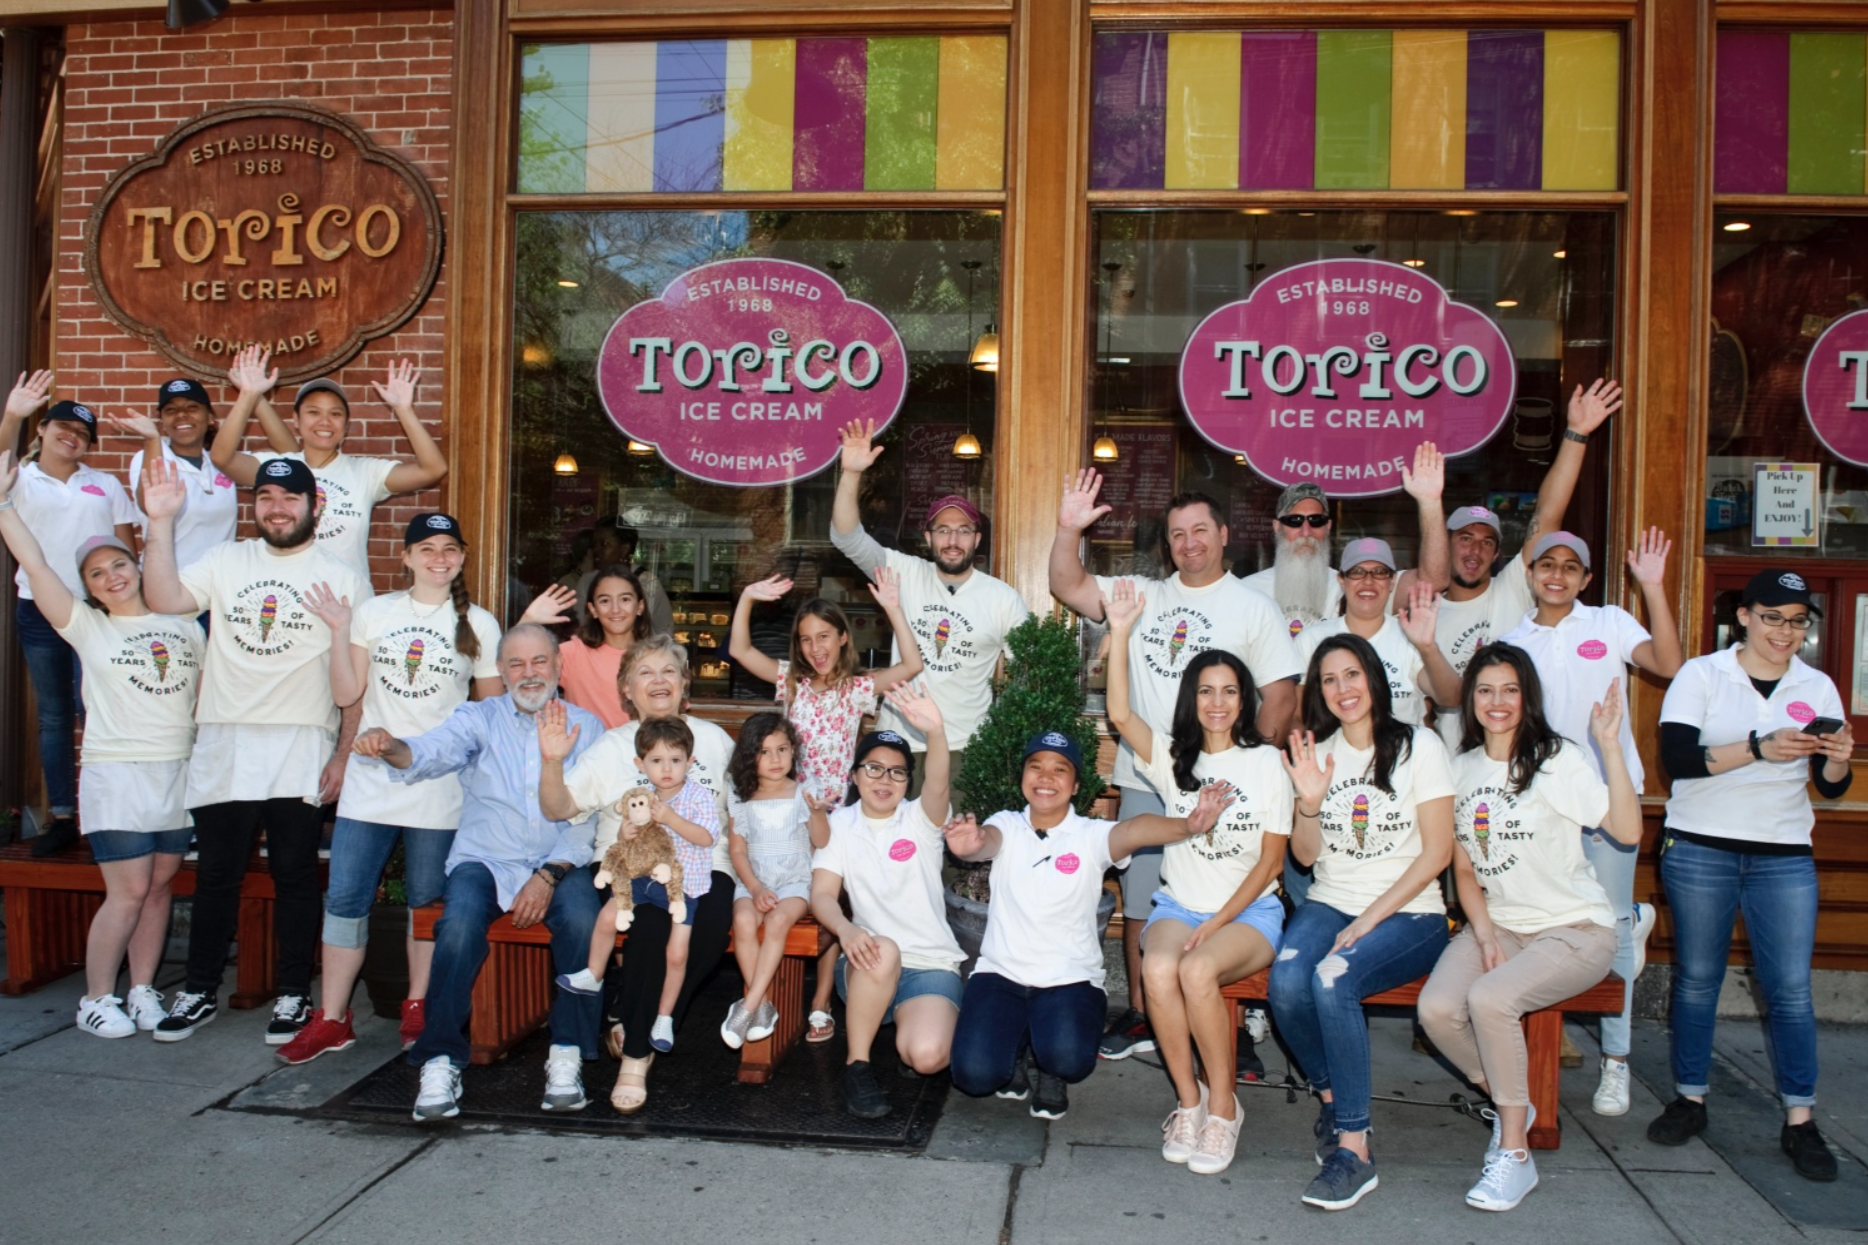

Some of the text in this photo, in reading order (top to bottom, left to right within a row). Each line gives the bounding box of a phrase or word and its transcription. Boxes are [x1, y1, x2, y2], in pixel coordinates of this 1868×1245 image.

[189, 134, 336, 165] ESTABLISHED
[233, 158, 283, 175] 1968
[183, 276, 338, 301] ICE CREAM
[687, 276, 822, 302] ESTABLISHED
[1276, 278, 1423, 304] ESTABLISHED
[728, 299, 773, 313] 1968
[1321, 301, 1371, 315] 1968
[680, 402, 823, 421] ICE CREAM
[1270, 409, 1425, 428] ICE CREAM
[690, 446, 807, 471] HOMEMADE
[1281, 456, 1406, 480] HOMEMADE
[1767, 471, 1804, 483] Pick Up
[1773, 486, 1797, 495] Here
[1775, 500, 1795, 509] And
[333, 509, 361, 518] TASTY
[1764, 514, 1802, 523] ENJOY!
[237, 579, 304, 604] CELEBRATING
[233, 606, 245, 614] 50
[281, 620, 313, 631] TASTY
[1150, 627, 1160, 635] 50
[234, 635, 294, 656] MEMORIES!
[961, 640, 973, 648] OF
[378, 646, 388, 654] 50
[952, 647, 978, 658] TASTY
[110, 658, 146, 666] YEARS
[439, 657, 453, 665] OF
[1455, 661, 1466, 670] 50
[428, 664, 460, 677] TASTY
[128, 675, 189, 695] MEMORIES!
[380, 676, 441, 699] MEMORIES!
[1236, 812, 1251, 820] OF
[1320, 811, 1332, 820] 50
[1385, 812, 1401, 820] OF
[1226, 822, 1261, 831] TASTY
[1377, 820, 1412, 832] TASTY
[1505, 820, 1521, 829] OF
[1497, 832, 1534, 840] TASTY
